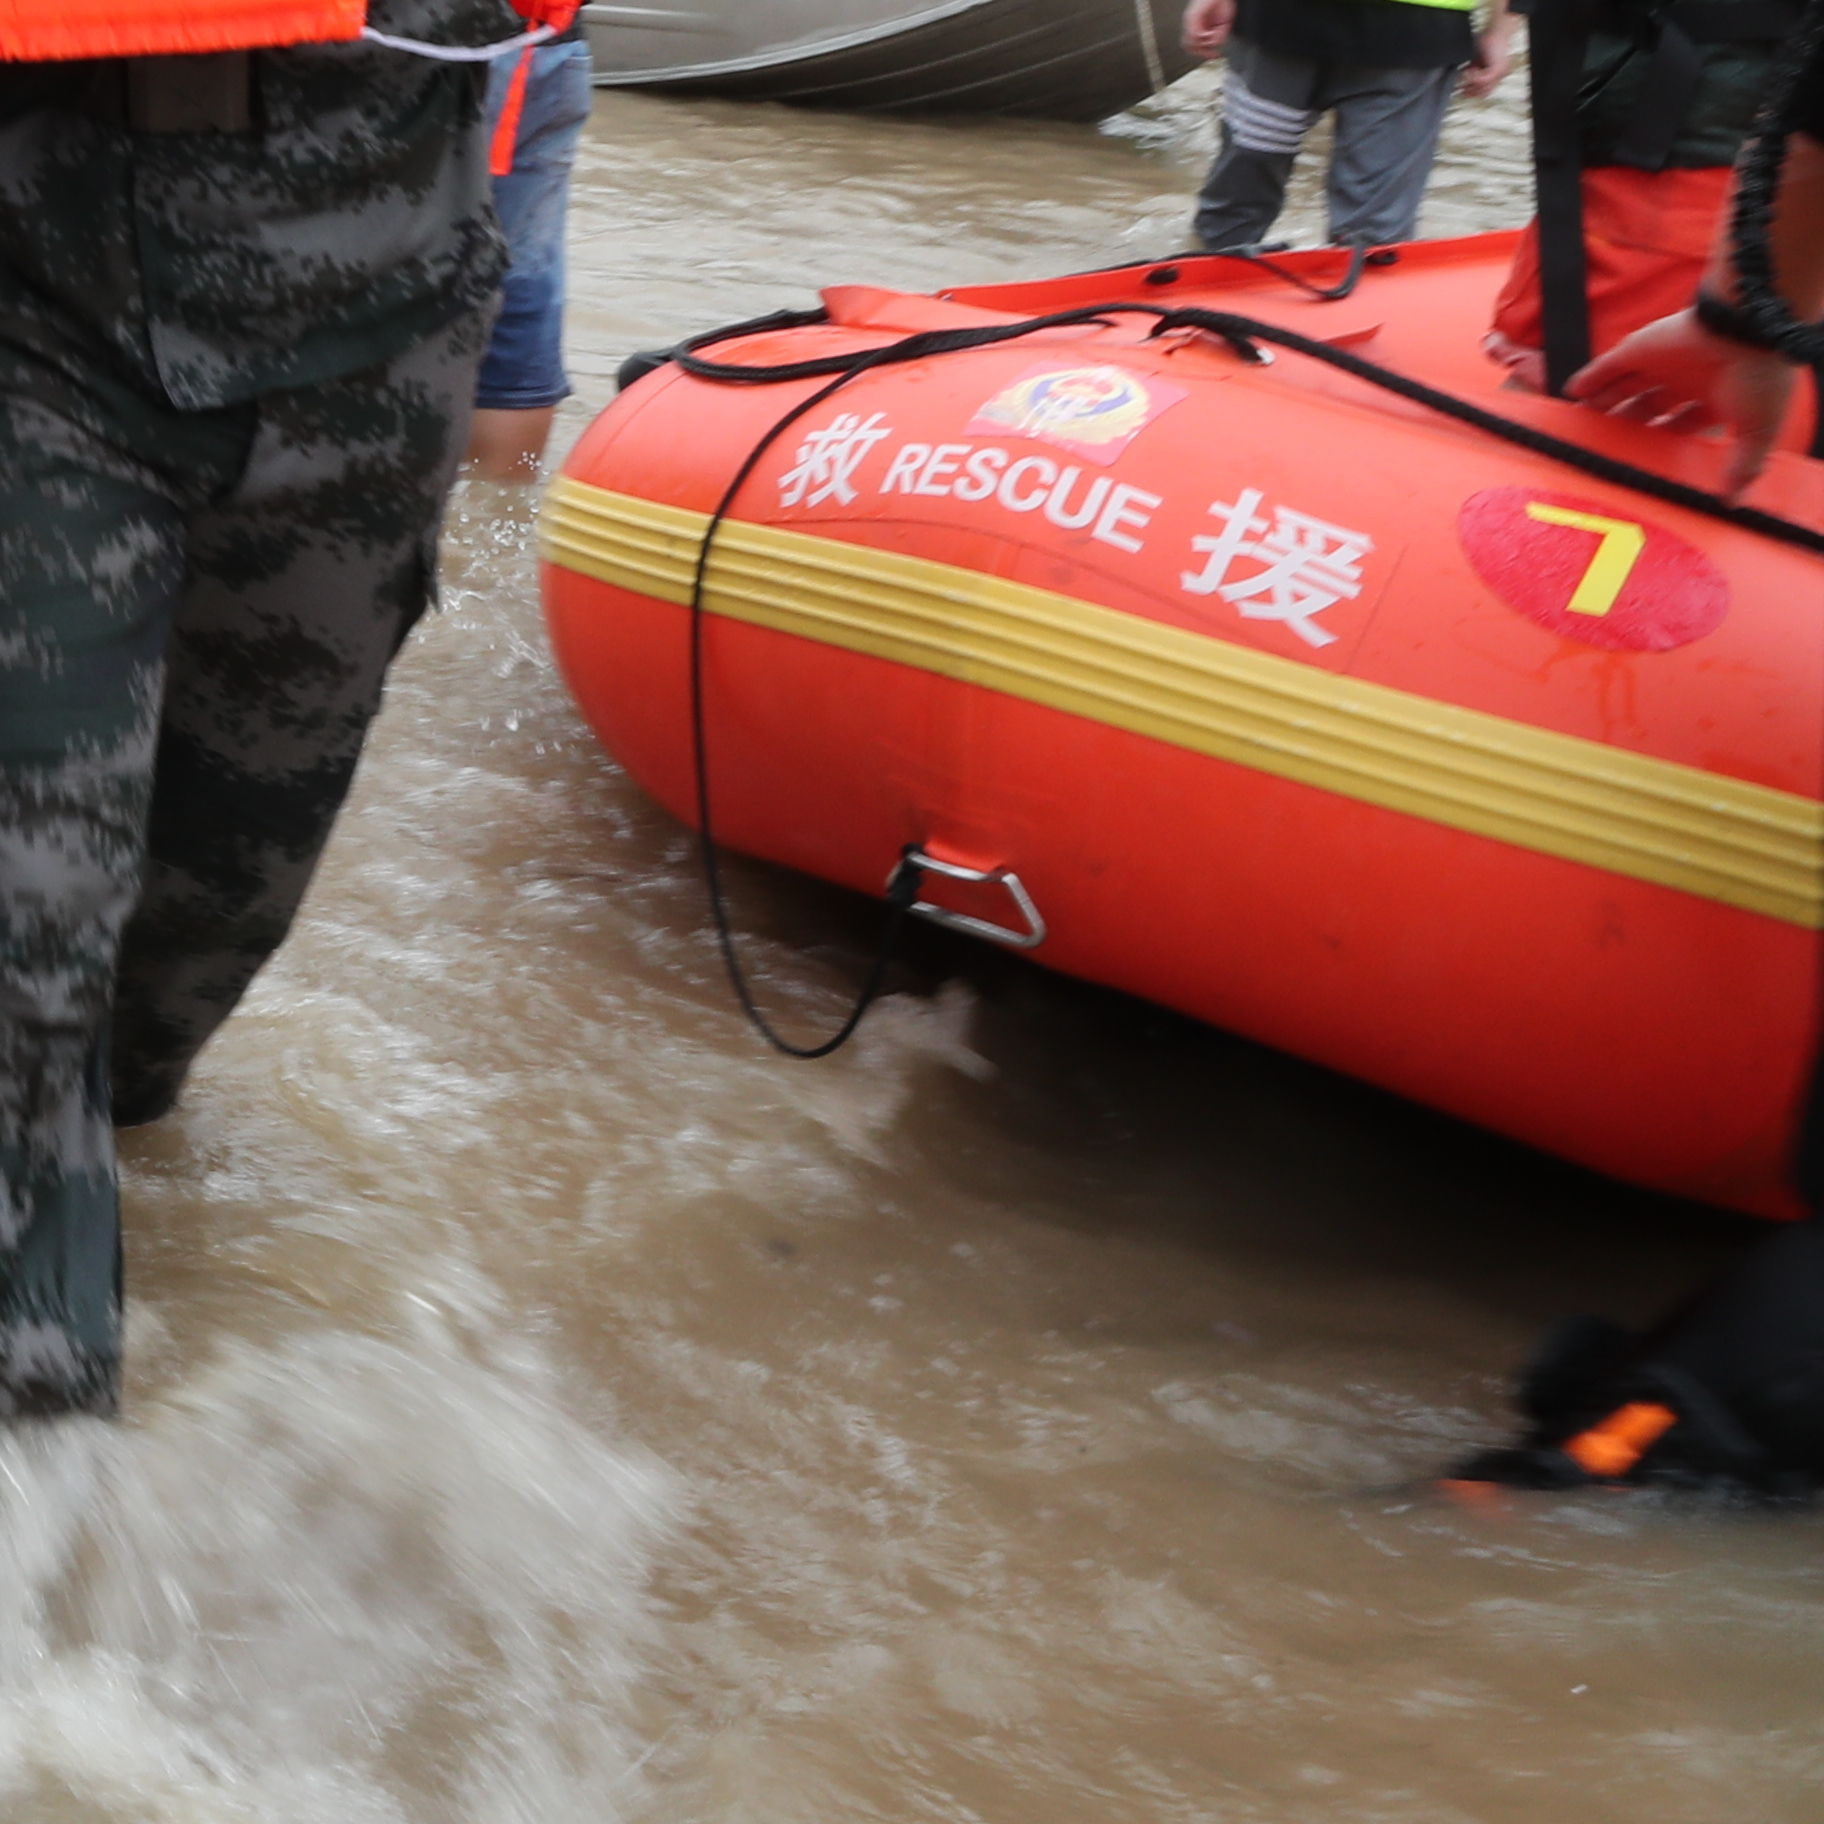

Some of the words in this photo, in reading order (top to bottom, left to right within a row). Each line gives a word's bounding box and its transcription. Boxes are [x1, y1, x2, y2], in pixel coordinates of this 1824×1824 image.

[778, 412, 892, 508] 救
[880, 443, 1162, 554] RESCUE
[1181, 487, 1374, 649] 援
[1524, 500, 1647, 618] 7
